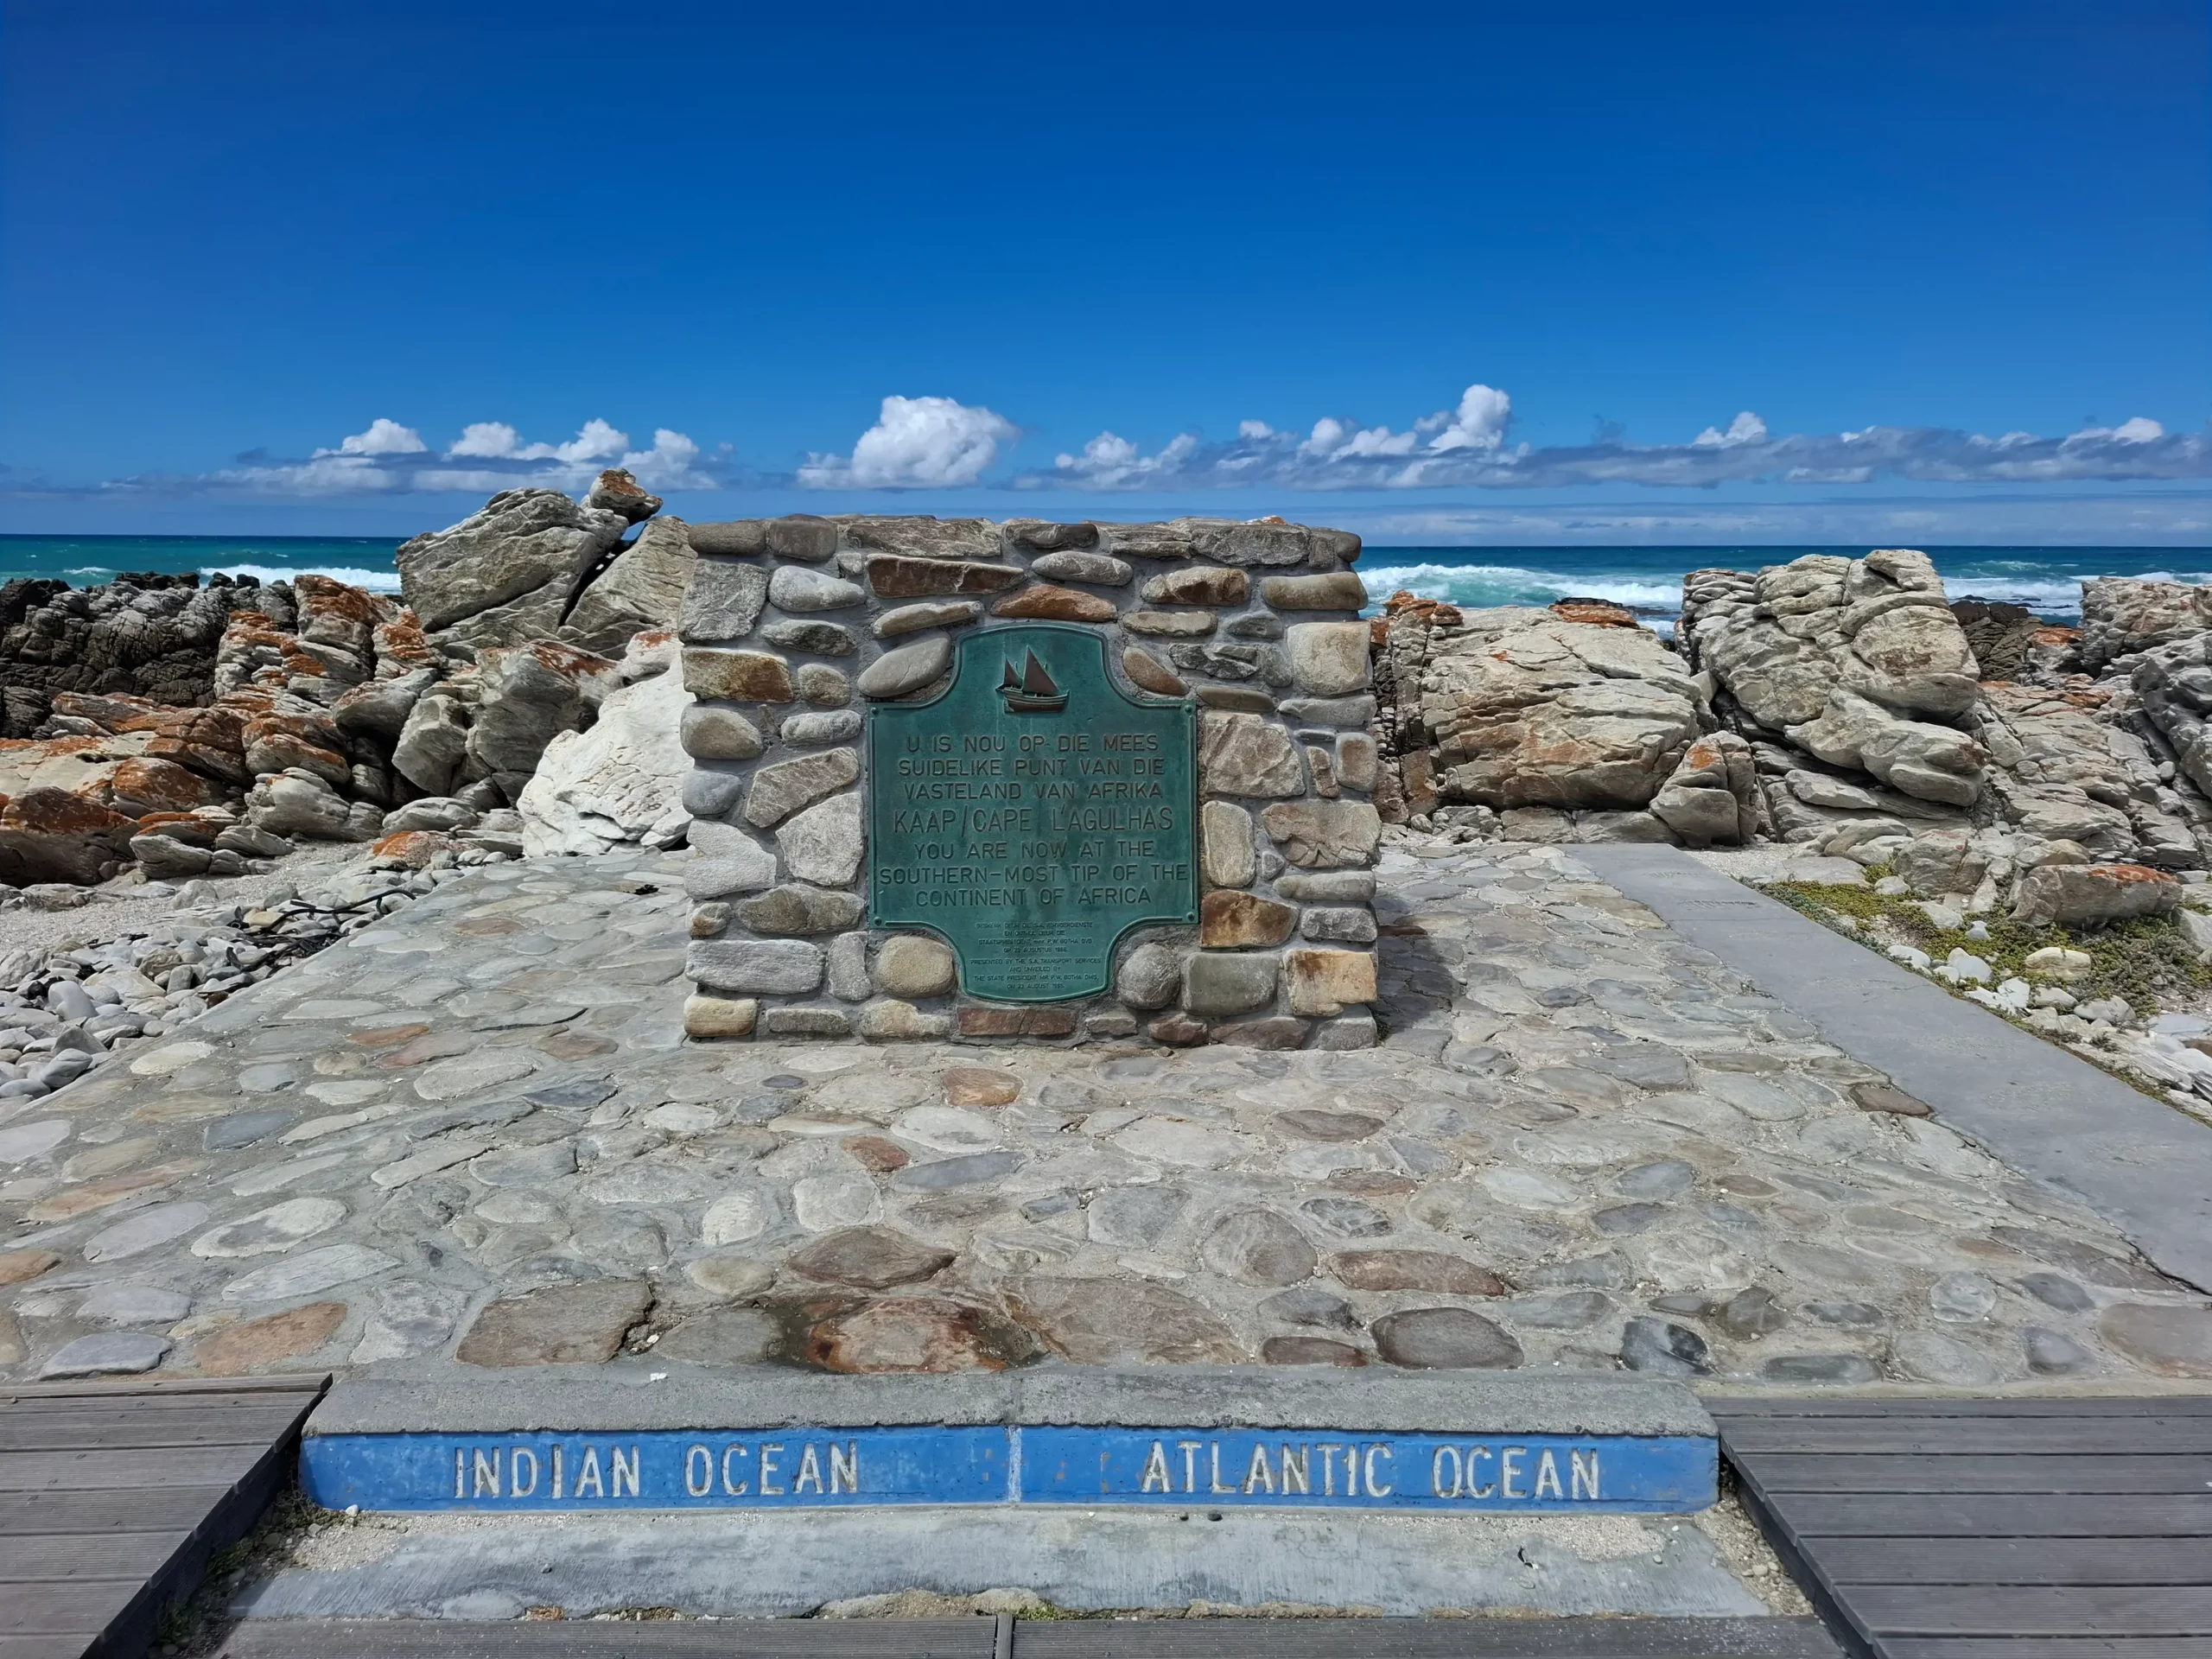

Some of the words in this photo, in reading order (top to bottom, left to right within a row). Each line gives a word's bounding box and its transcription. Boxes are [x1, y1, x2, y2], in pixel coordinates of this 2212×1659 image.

[907, 734, 920, 753] U
[933, 734, 951, 753] IS
[963, 734, 1006, 753] NOU
[1019, 734, 1045, 753] OP
[1058, 734, 1090, 753] DIE
[1103, 734, 1159, 752] MEES
[898, 759, 1003, 777] SUIDELIKE
[1014, 758, 1066, 776] PUNT
[1080, 758, 1120, 775] VAN
[1133, 757, 1166, 775] DIE
[903, 782, 1021, 800] VASTELAND
[1034, 781, 1076, 799] VAN
[1087, 781, 1164, 799] AFRIKA
[893, 805, 1033, 837] KAAP/CAPE
[1052, 804, 1173, 831] L'AGULHAS
[913, 842, 955, 860] YOU
[966, 842, 1008, 860] ARE
[1021, 841, 1068, 859] NOW
[1079, 840, 1104, 858] AT
[1116, 840, 1155, 857] THE
[879, 865, 1058, 885] SOUTHERN-MOST
[1071, 865, 1100, 882] TIP
[1112, 864, 1138, 881] OF
[1151, 863, 1188, 881] THE
[915, 888, 1027, 907] CONTINENT
[1039, 887, 1065, 906] OF
[1077, 887, 1152, 905] AFRICA
[454, 1444, 639, 1499] INDIAN
[684, 1440, 859, 1497] OCEAN
[1141, 1439, 1393, 1497] ATLANTIC
[1432, 1443, 1600, 1501] OCEAN
